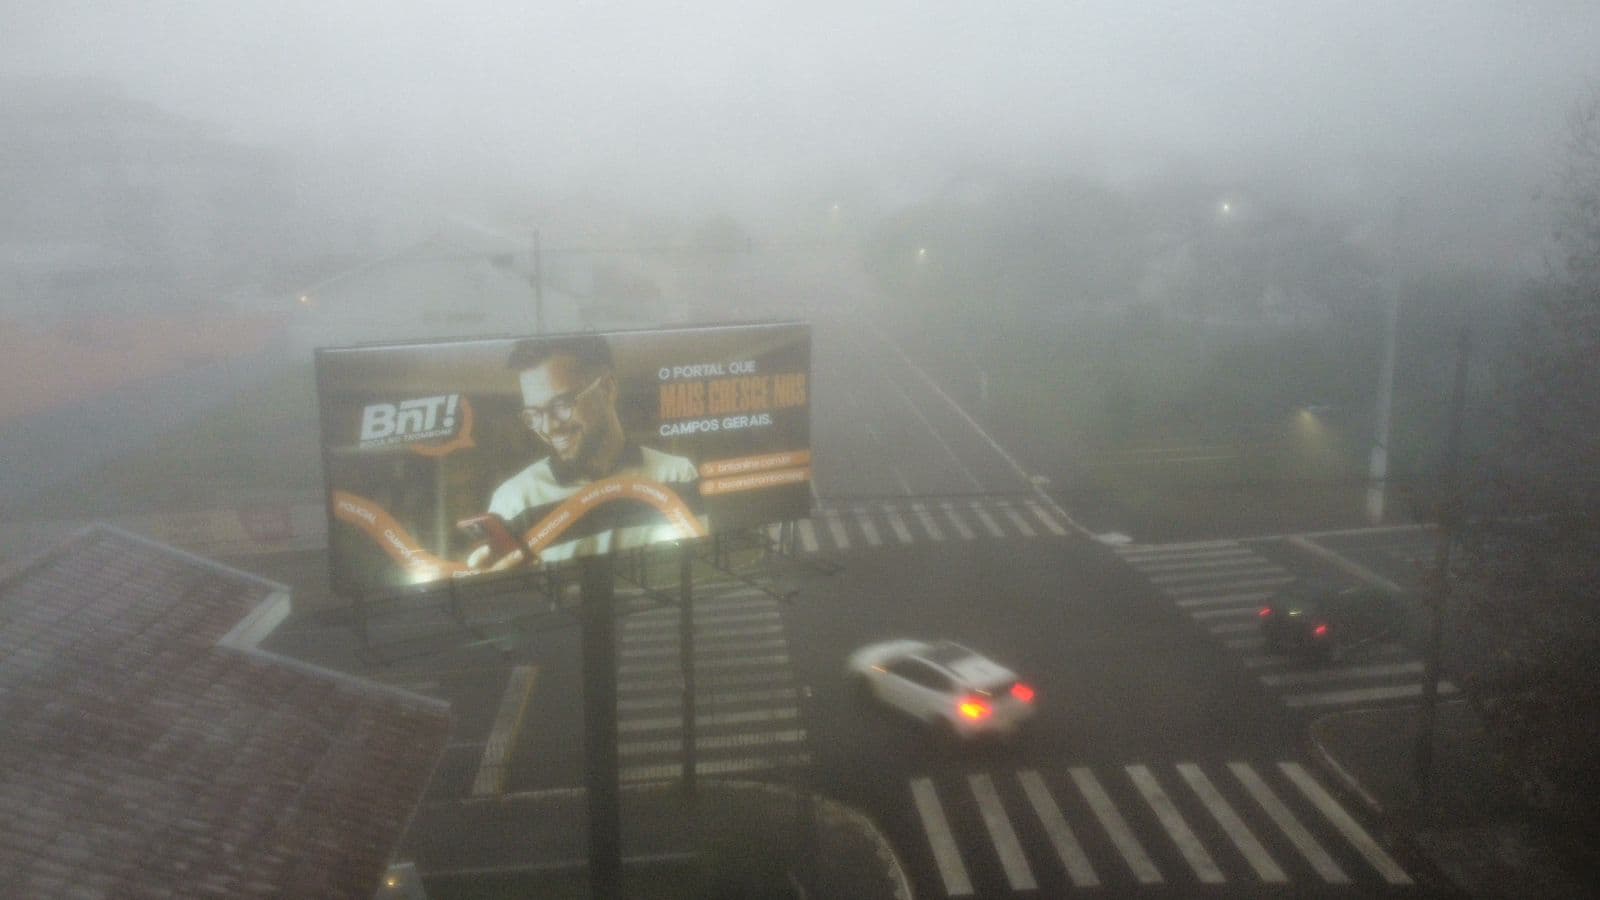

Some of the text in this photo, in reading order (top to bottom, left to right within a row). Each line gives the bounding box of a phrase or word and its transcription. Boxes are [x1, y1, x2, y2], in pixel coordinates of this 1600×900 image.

[658, 360, 756, 380] O PORTAL QUE
[659, 382, 705, 420] MAIS
[660, 413, 773, 437] CAMPOS GERAIS.
